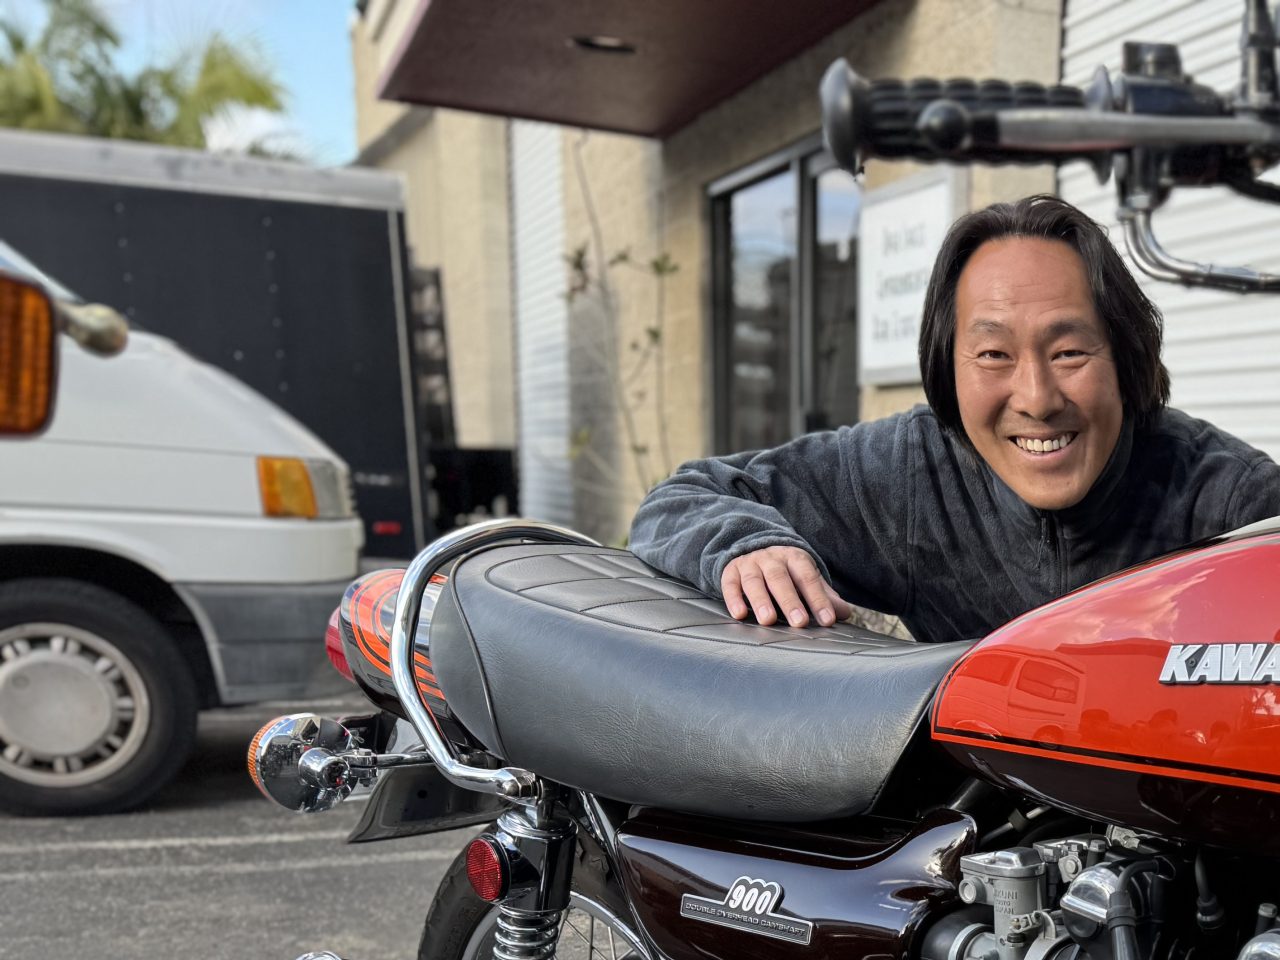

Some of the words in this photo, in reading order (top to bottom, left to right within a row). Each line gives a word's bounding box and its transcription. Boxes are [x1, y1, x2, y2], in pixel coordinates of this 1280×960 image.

[728, 884, 772, 915] 900
[685, 902, 716, 915] DOUBLE
[717, 909, 760, 925] OVERHEAD
[760, 919, 806, 937] CAMSHAFT
